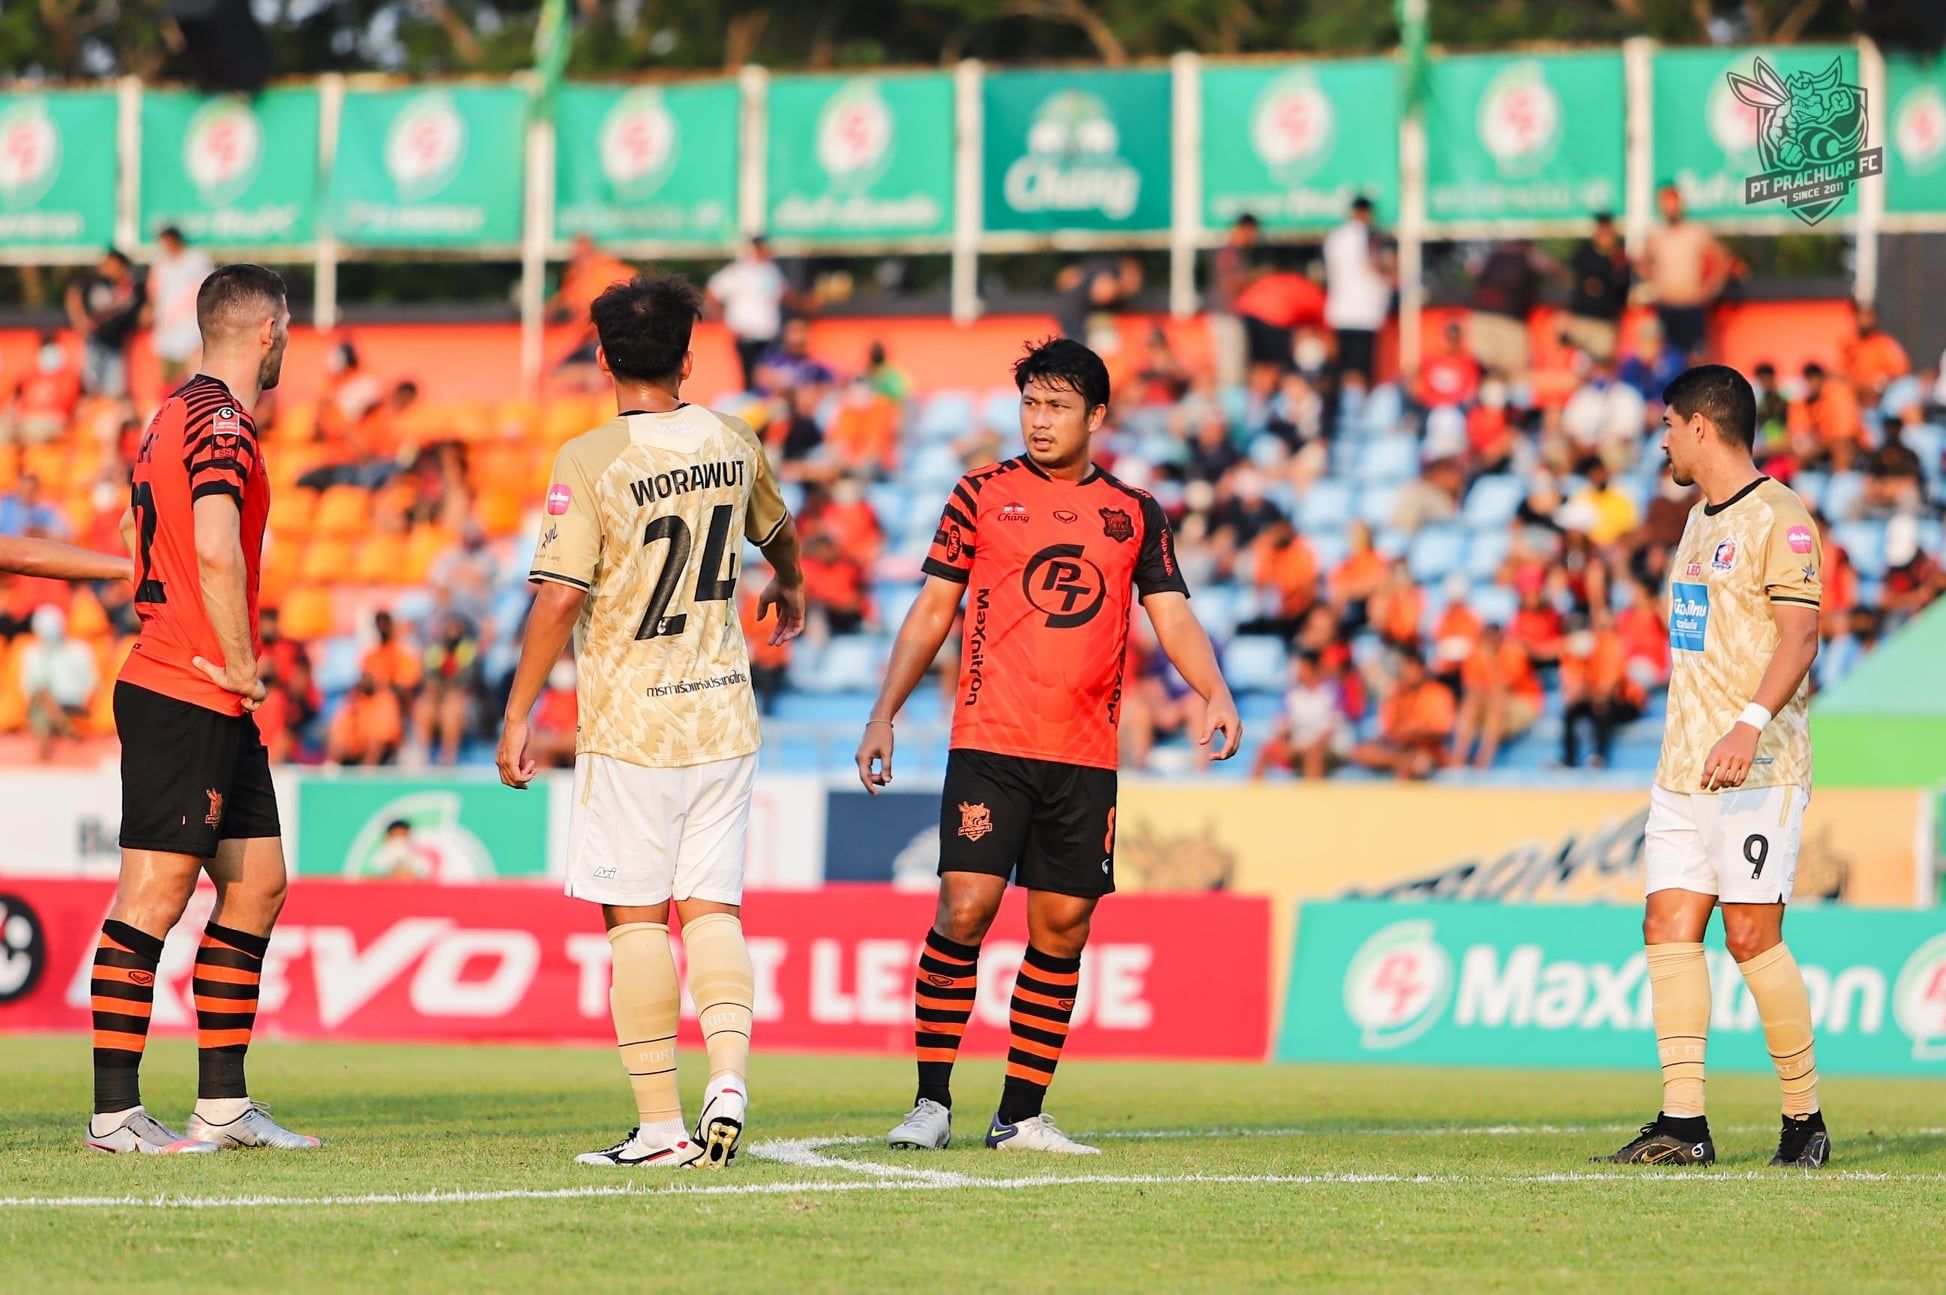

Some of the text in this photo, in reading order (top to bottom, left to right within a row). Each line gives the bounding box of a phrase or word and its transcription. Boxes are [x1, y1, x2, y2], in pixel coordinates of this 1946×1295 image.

[629, 460, 745, 507] WORAWUT
[997, 512, 1030, 523] Chang
[634, 504, 737, 641] 24
[1041, 560, 1092, 612] PT
[1686, 563, 1701, 577] LEO
[1743, 833, 1769, 879] 9
